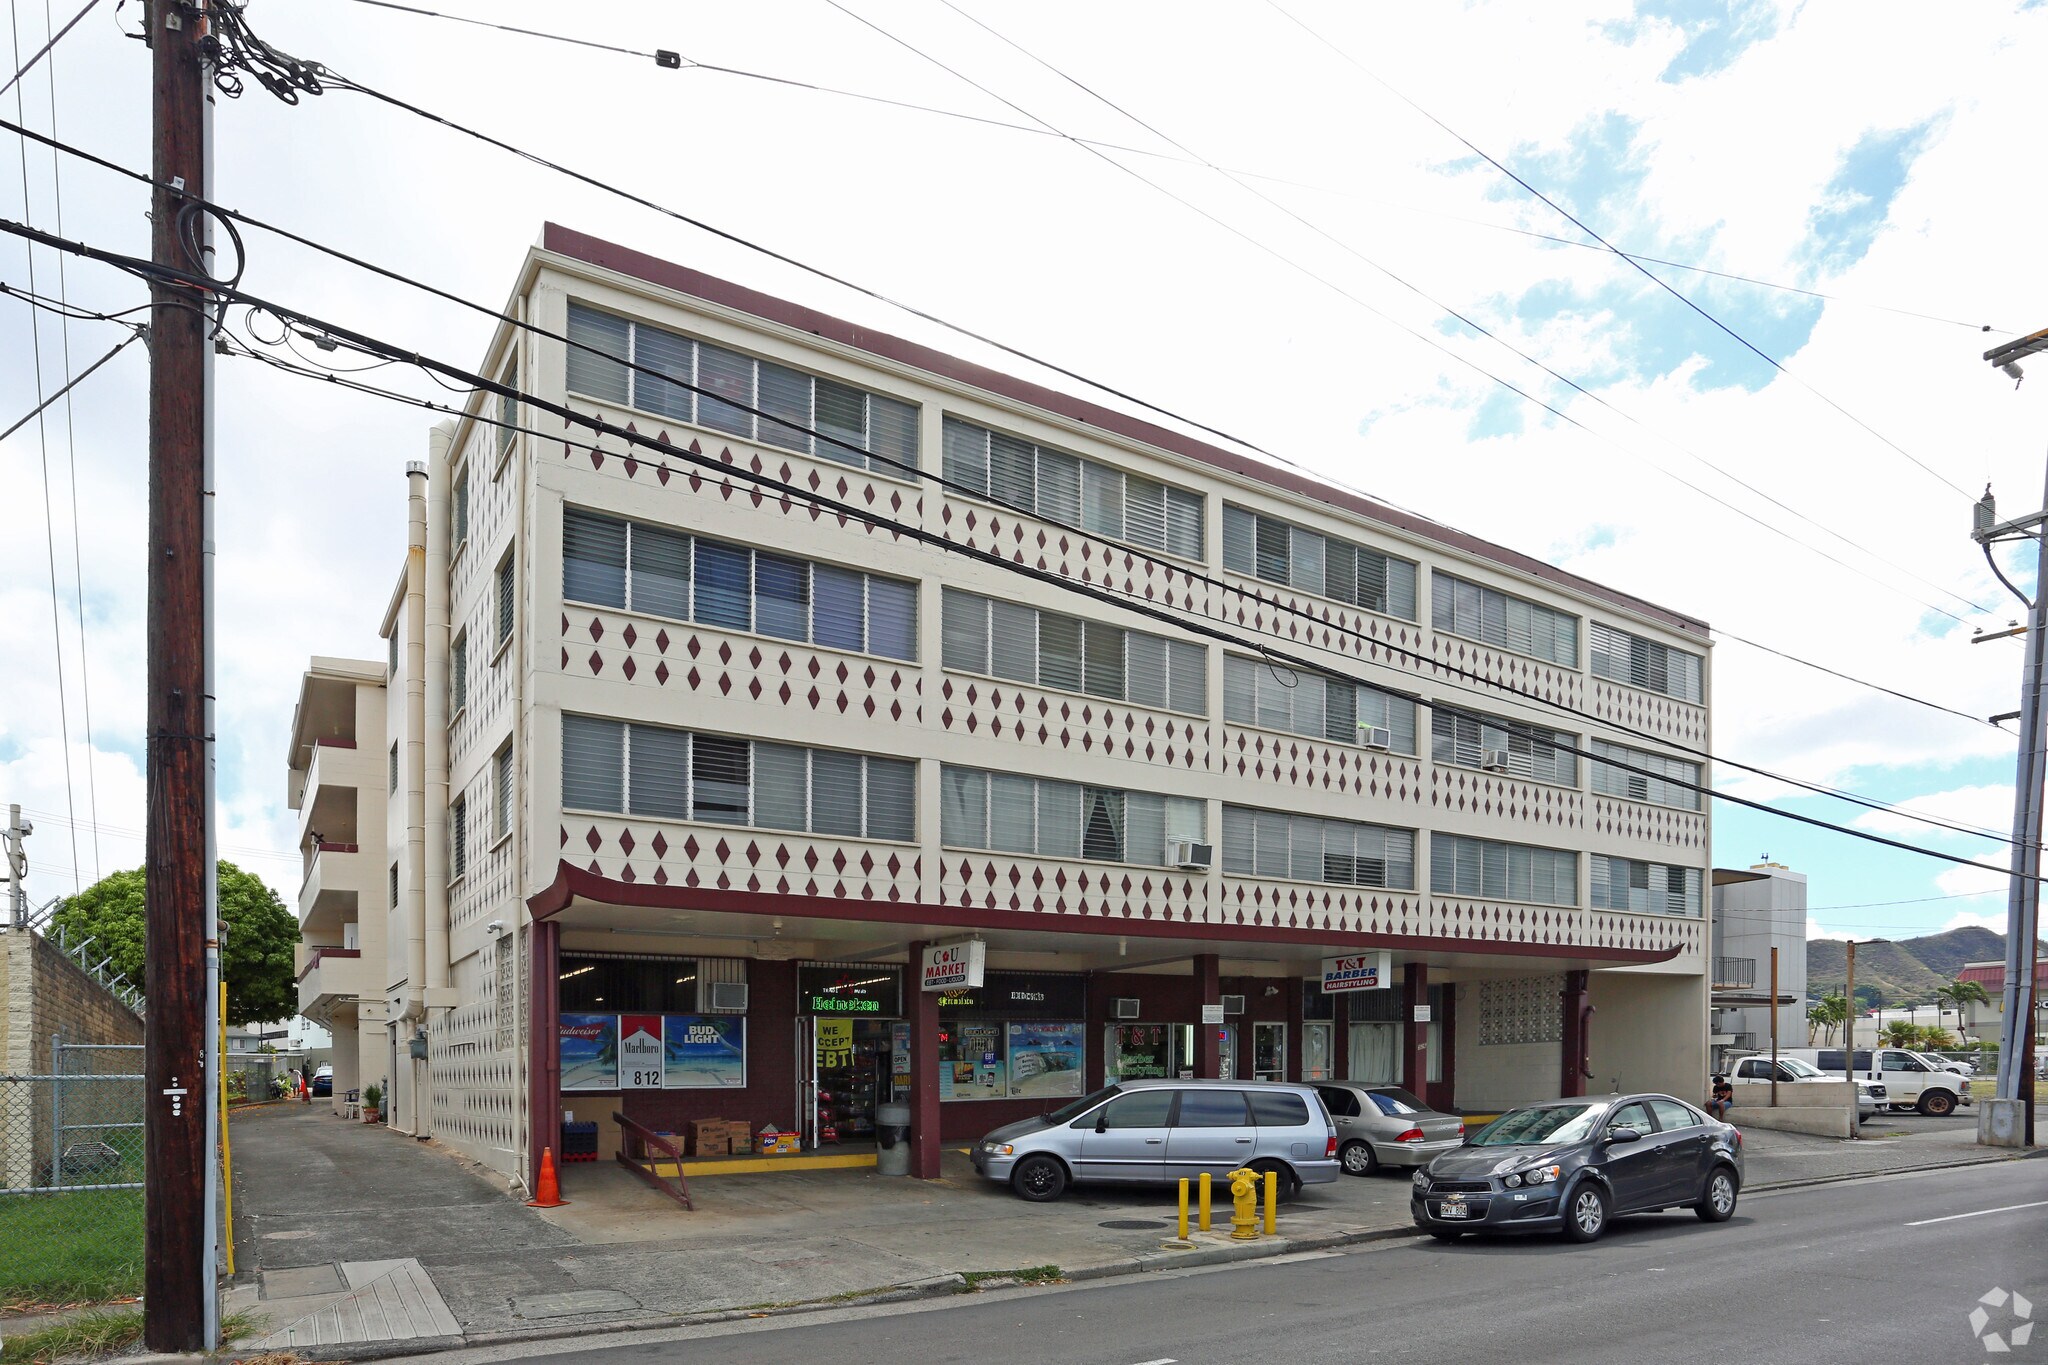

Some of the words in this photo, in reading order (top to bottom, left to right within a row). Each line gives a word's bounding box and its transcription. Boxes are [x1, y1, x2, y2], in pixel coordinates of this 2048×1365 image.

[933, 950, 941, 965] C
[951, 947, 959, 962] U
[925, 962, 966, 978] MARKET
[1336, 957, 1366, 971] T&T
[1325, 967, 1377, 981] BARBER
[1326, 978, 1375, 990] HAIRSTYLING
[812, 996, 880, 1011] Heineken
[560, 1026, 601, 1036] udweiser
[689, 1026, 714, 1035] BUD
[823, 1027, 838, 1035] WE
[1115, 1026, 1126, 1046] T
[1132, 1026, 1145, 1046] &
[1151, 1026, 1161, 1046] T
[624, 1038, 659, 1054] Marlboro
[684, 1035, 719, 1044] LIGHT
[818, 1037, 850, 1047] CCEPT
[969, 1037, 995, 1051] OPEN
[816, 1050, 849, 1068] EBT
[985, 1052, 995, 1060] EBT
[1120, 1054, 1155, 1064] Barber
